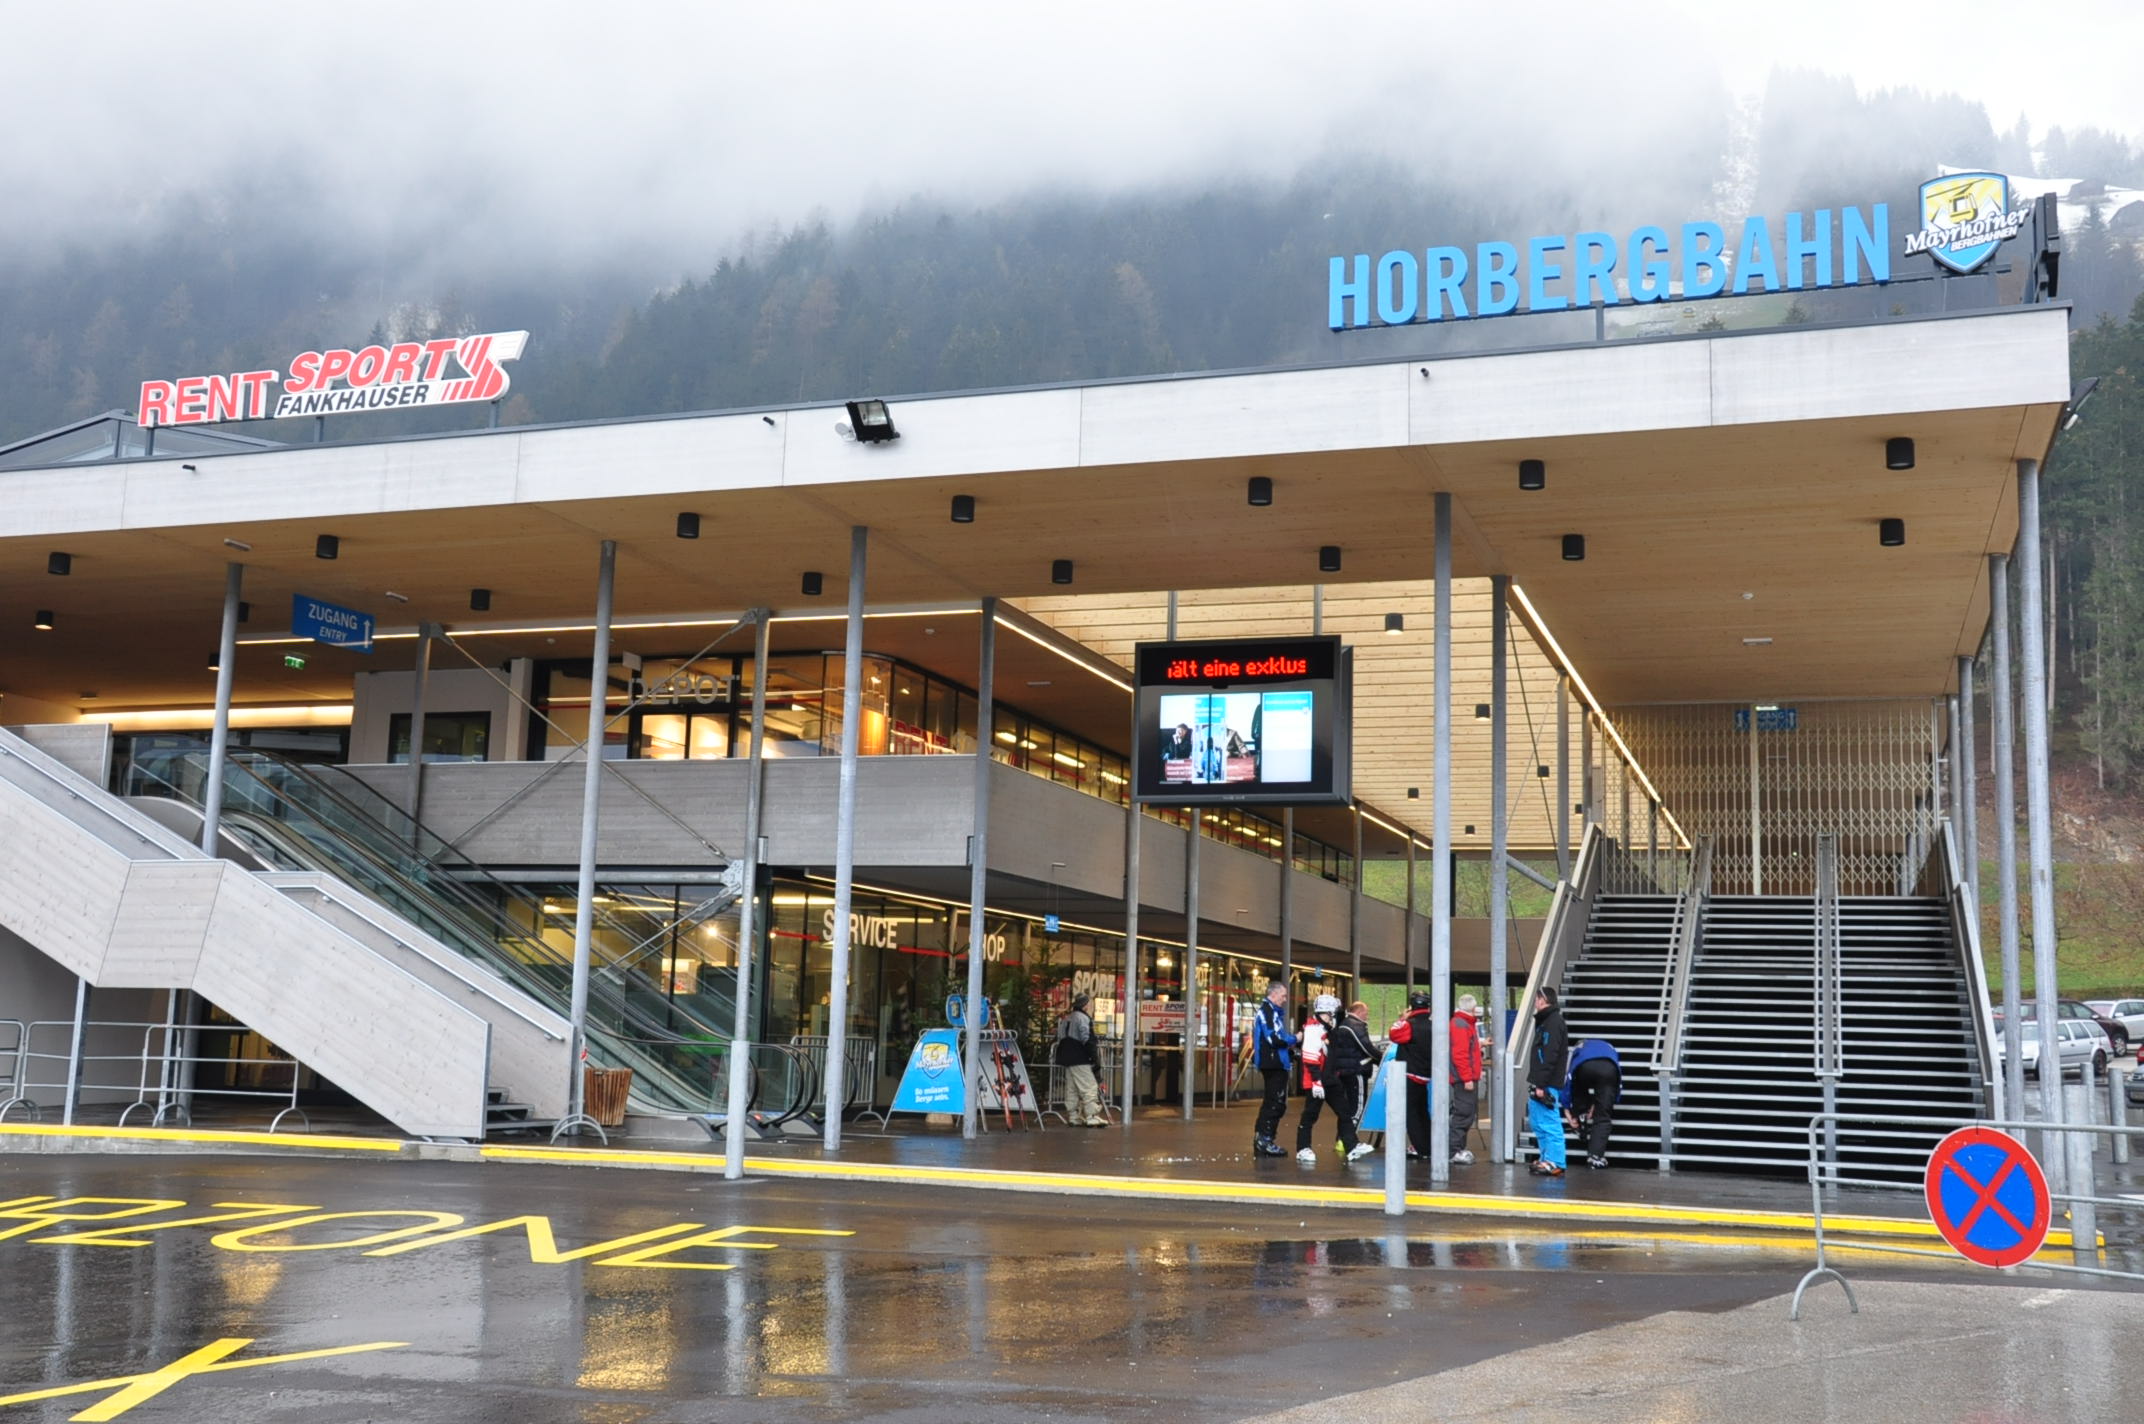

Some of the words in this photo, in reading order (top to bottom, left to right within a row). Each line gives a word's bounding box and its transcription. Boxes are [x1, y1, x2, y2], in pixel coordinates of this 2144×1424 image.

[1904, 208, 2030, 255] Mayrhofner
[1951, 225, 2018, 251] BERGBAHNEN
[1328, 202, 1890, 332] HORBERGBAHN
[138, 370, 277, 427] RENT
[283, 337, 460, 393] SPORT
[277, 384, 430, 416] FANKHAUSER
[308, 603, 358, 630] ZUGANG
[319, 625, 348, 641] ENTRY
[1203, 659, 1240, 677] eine
[628, 674, 740, 705] DEPOT
[822, 908, 898, 950] SRVICE
[968, 933, 1006, 963] OP
[1142, 1004, 1163, 1012] RENT
[0, 1195, 856, 1270] RZONE
